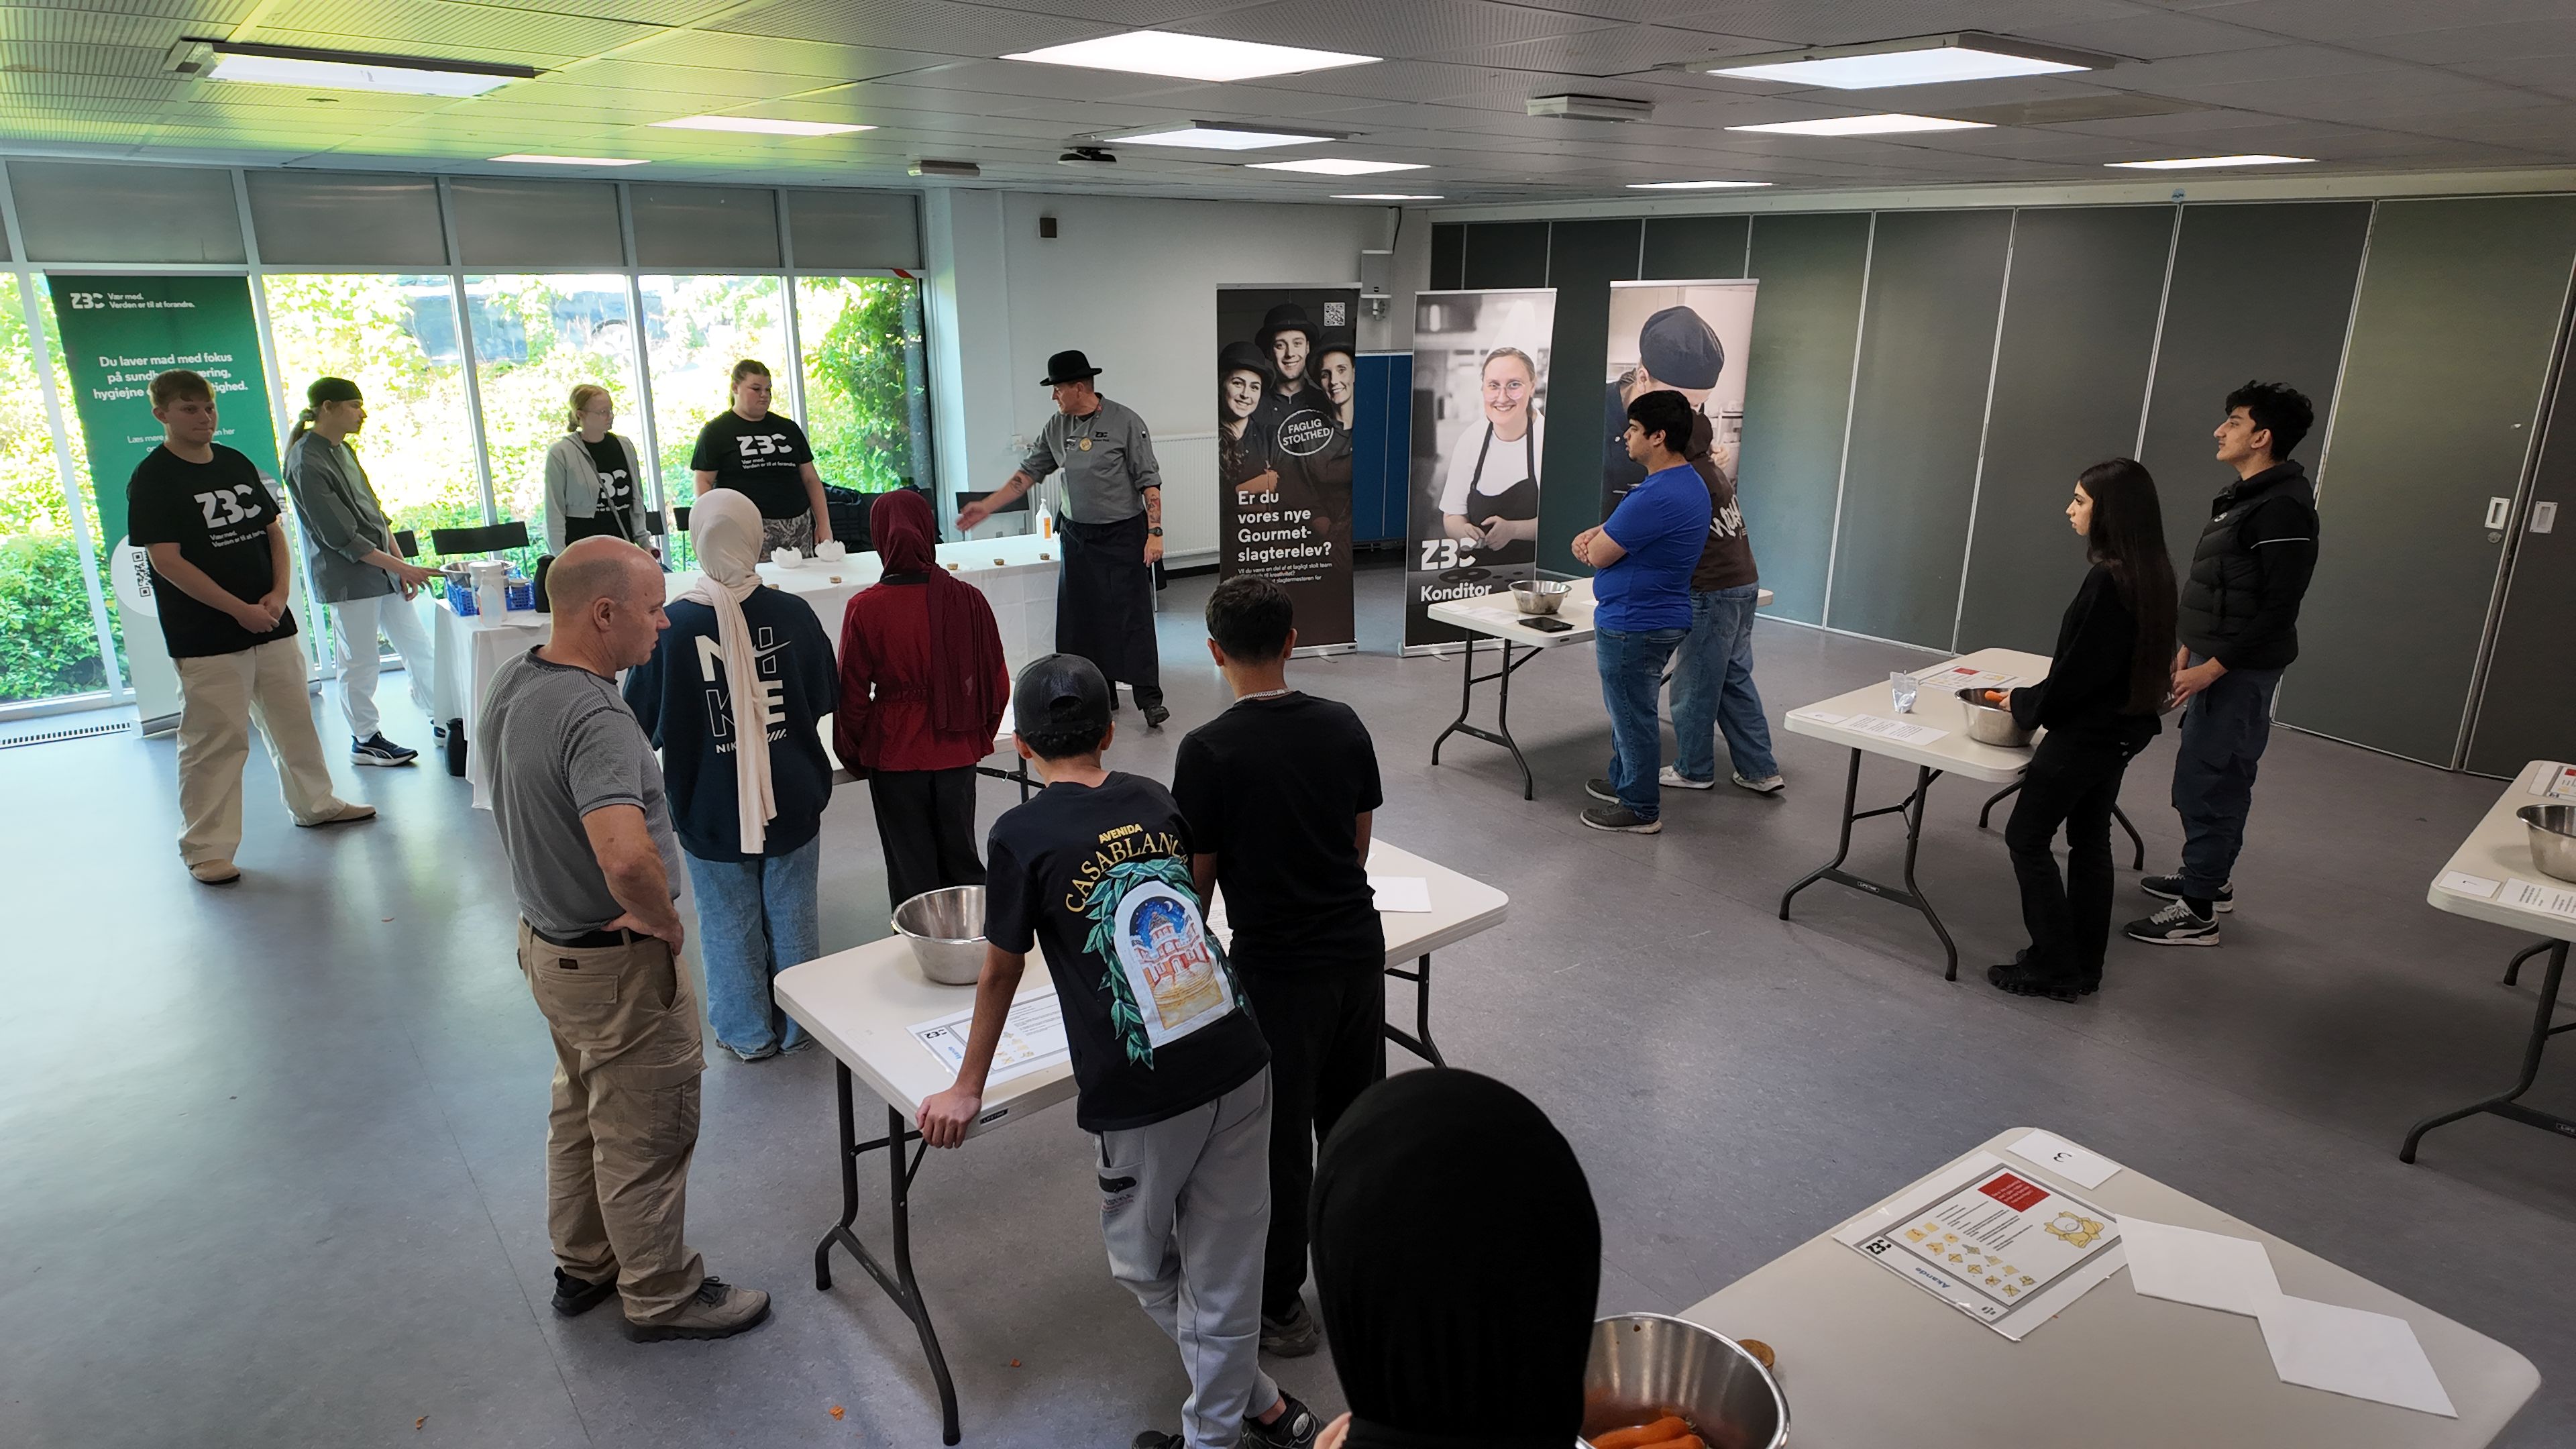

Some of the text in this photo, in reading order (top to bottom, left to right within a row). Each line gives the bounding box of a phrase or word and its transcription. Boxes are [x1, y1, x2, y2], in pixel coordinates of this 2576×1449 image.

[109, 301, 137, 309] Verden
[164, 301, 195, 309] forandre.
[99, 352, 233, 368] Du laver mad med fokus
[107, 371, 123, 384] på
[93, 387, 144, 400] hygiejne
[1287, 418, 1322, 434] FAGLIG
[127, 435, 144, 444] Læs
[223, 427, 235, 435] her
[1283, 427, 1330, 446] STOLTHED
[1238, 489, 1279, 505] Er du
[1238, 509, 1311, 524] vores nye
[1238, 525, 1311, 543] Gourmet-
[1238, 541, 1332, 563] slagterelev?
[1421, 582, 1492, 602] Konditor
[1098, 823, 1143, 844] AVENIDA
